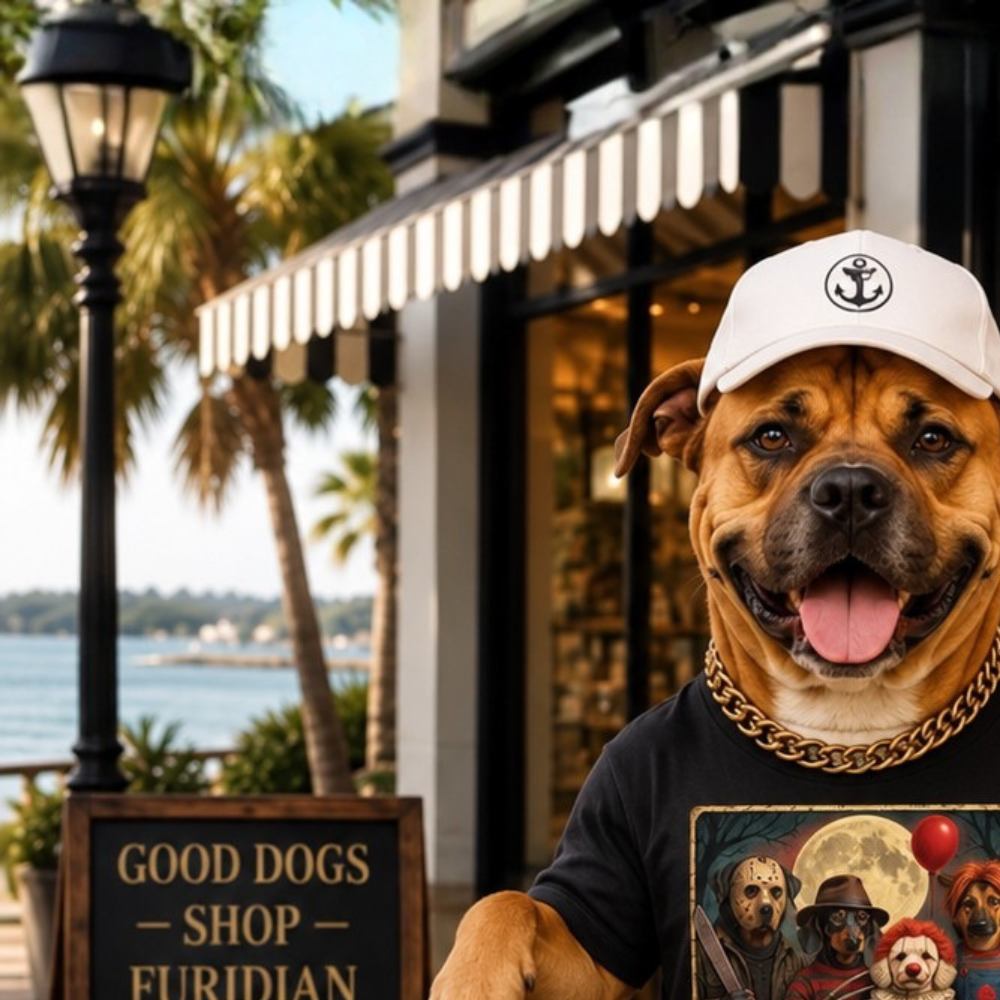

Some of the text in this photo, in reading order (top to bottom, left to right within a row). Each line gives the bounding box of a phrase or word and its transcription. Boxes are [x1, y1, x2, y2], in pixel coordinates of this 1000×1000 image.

[117, 843, 370, 885] GOOD DOGS
[183, 904, 301, 947] SHOP
